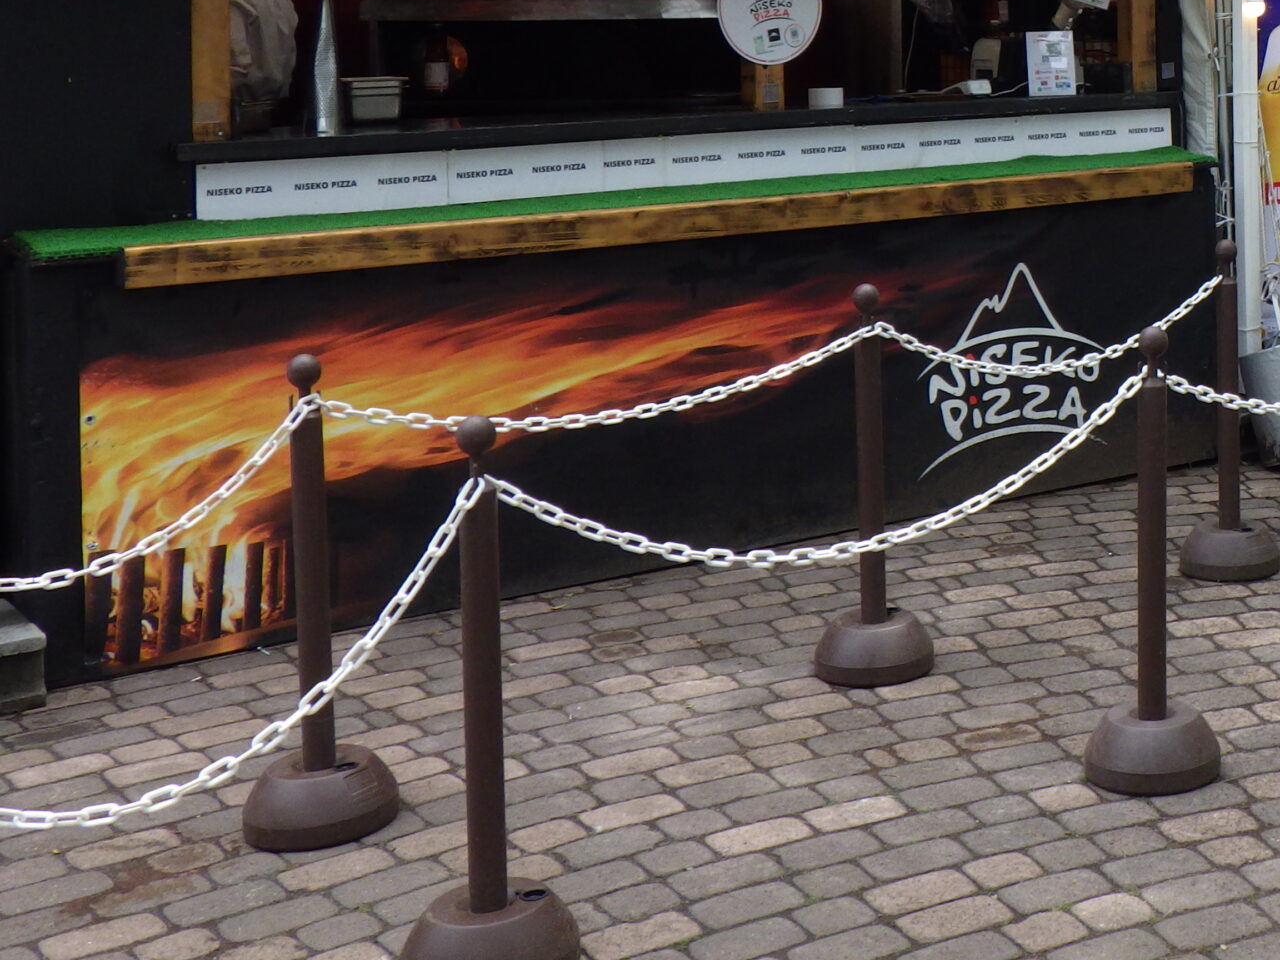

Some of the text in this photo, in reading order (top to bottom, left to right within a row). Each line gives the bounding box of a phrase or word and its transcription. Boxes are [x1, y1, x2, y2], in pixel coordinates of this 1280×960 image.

[997, 134, 1015, 142] PIZZA
[801, 145, 847, 155] NISEKO PIZZA
[861, 142, 905, 151] NISEKO PIZZA
[672, 153, 722, 164] NISEKO PIZZA
[738, 149, 786, 159] NISEKO PIZZA
[532, 162, 586, 173] NISEKO PIZZA
[603, 157, 656, 168] NISEKO PIZZA
[456, 168, 513, 179] NISEKO PIZZA
[378, 174, 437, 185] NISEKO PIZZA
[206, 185, 273, 197] NISEKO PIZZA
[294, 180, 357, 191] NISEKO PIZZA
